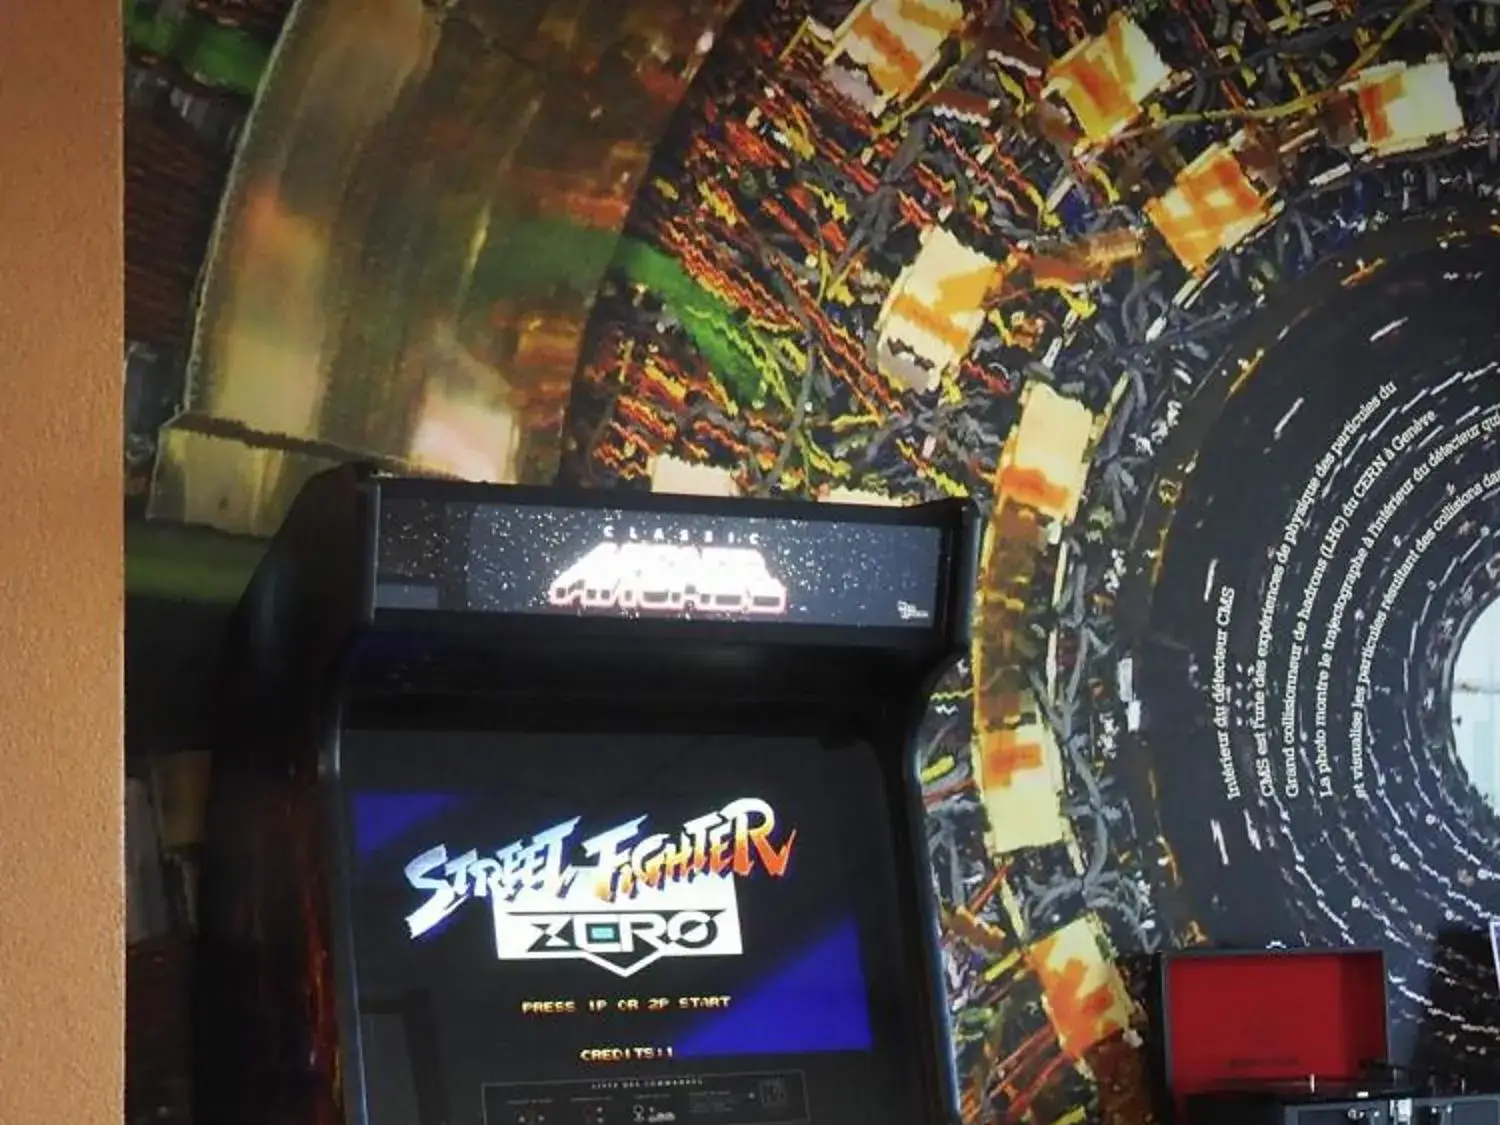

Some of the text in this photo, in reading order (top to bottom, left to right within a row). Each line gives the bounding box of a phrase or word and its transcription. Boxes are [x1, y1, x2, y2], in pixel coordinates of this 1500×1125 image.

[1379, 380, 1398, 401] du
[1331, 395, 1382, 457] particules
[1428, 423, 1481, 468] détecteur
[1315, 451, 1336, 479] des
[1352, 454, 1388, 498] CERN
[1383, 447, 1396, 461] à
[1412, 461, 1431, 482] du
[1284, 477, 1321, 546] physique
[1342, 498, 1360, 518] du
[1433, 481, 1483, 532] collisions
[603, 525, 760, 545] CLASSIC
[1276, 543, 1291, 564] de
[1320, 515, 1350, 559] (LHC)
[1361, 536, 1375, 549] à
[1414, 526, 1437, 552] des
[1296, 557, 1328, 621] hadrons
[1321, 547, 1368, 650] trajectographe
[1381, 548, 1421, 611] résultant
[1257, 563, 1285, 658] expériences
[1291, 620, 1308, 642] de
[1318, 652, 1333, 669] le
[1358, 609, 1387, 684] particules
[1211, 585, 1240, 800] Intérieur du détecteur CMS
[1254, 659, 1267, 688] des
[1281, 643, 1303, 744] collisionneur
[1350, 684, 1365, 707] les
[1315, 669, 1330, 727] montre
[1254, 733, 1268, 756] est
[1314, 728, 1333, 773] photo
[1349, 710, 1363, 780] visualise
[1256, 757, 1274, 797] CMS
[1282, 747, 1300, 798] Grand
[1319, 776, 1333, 798] La
[404, 797, 797, 940] STREET FIGHTER
[527, 909, 727, 953] ZERO
[521, 995, 732, 1014] PRESS 1P OR 2P START
